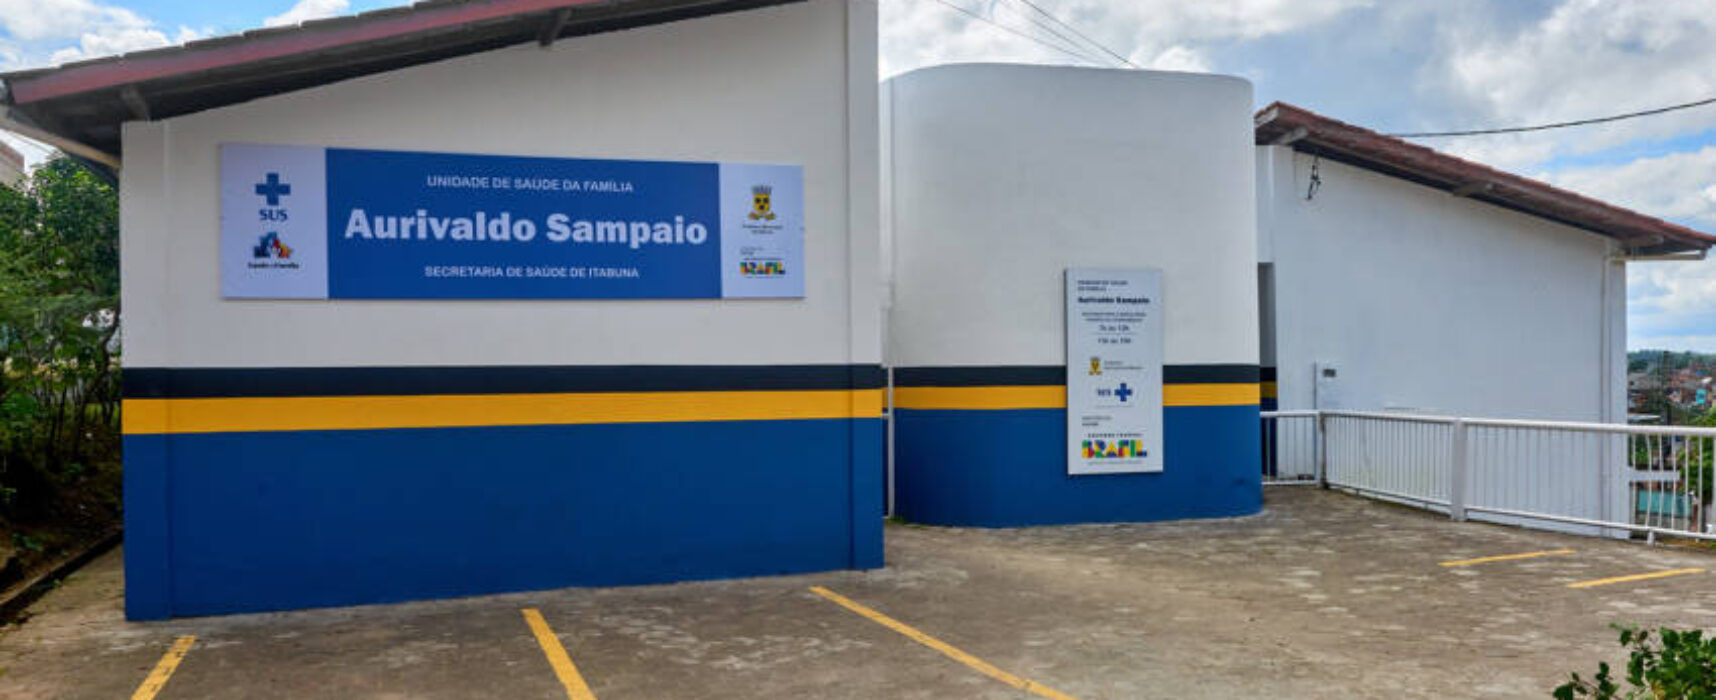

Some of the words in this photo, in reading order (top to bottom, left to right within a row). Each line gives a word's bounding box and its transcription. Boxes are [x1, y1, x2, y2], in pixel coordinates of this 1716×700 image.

[427, 175, 489, 189] UNIDADE
[492, 177, 511, 189] DE
[562, 180, 580, 192] DA
[259, 208, 288, 222] SUS
[344, 208, 537, 242] Aurivaldo
[546, 213, 708, 249] Sampaio
[425, 265, 503, 277] SECRETARIA
[506, 265, 524, 277] DE
[568, 267, 586, 278] DE
[588, 267, 640, 279] ITABUNA
[1081, 439, 1148, 459] BRASIL
